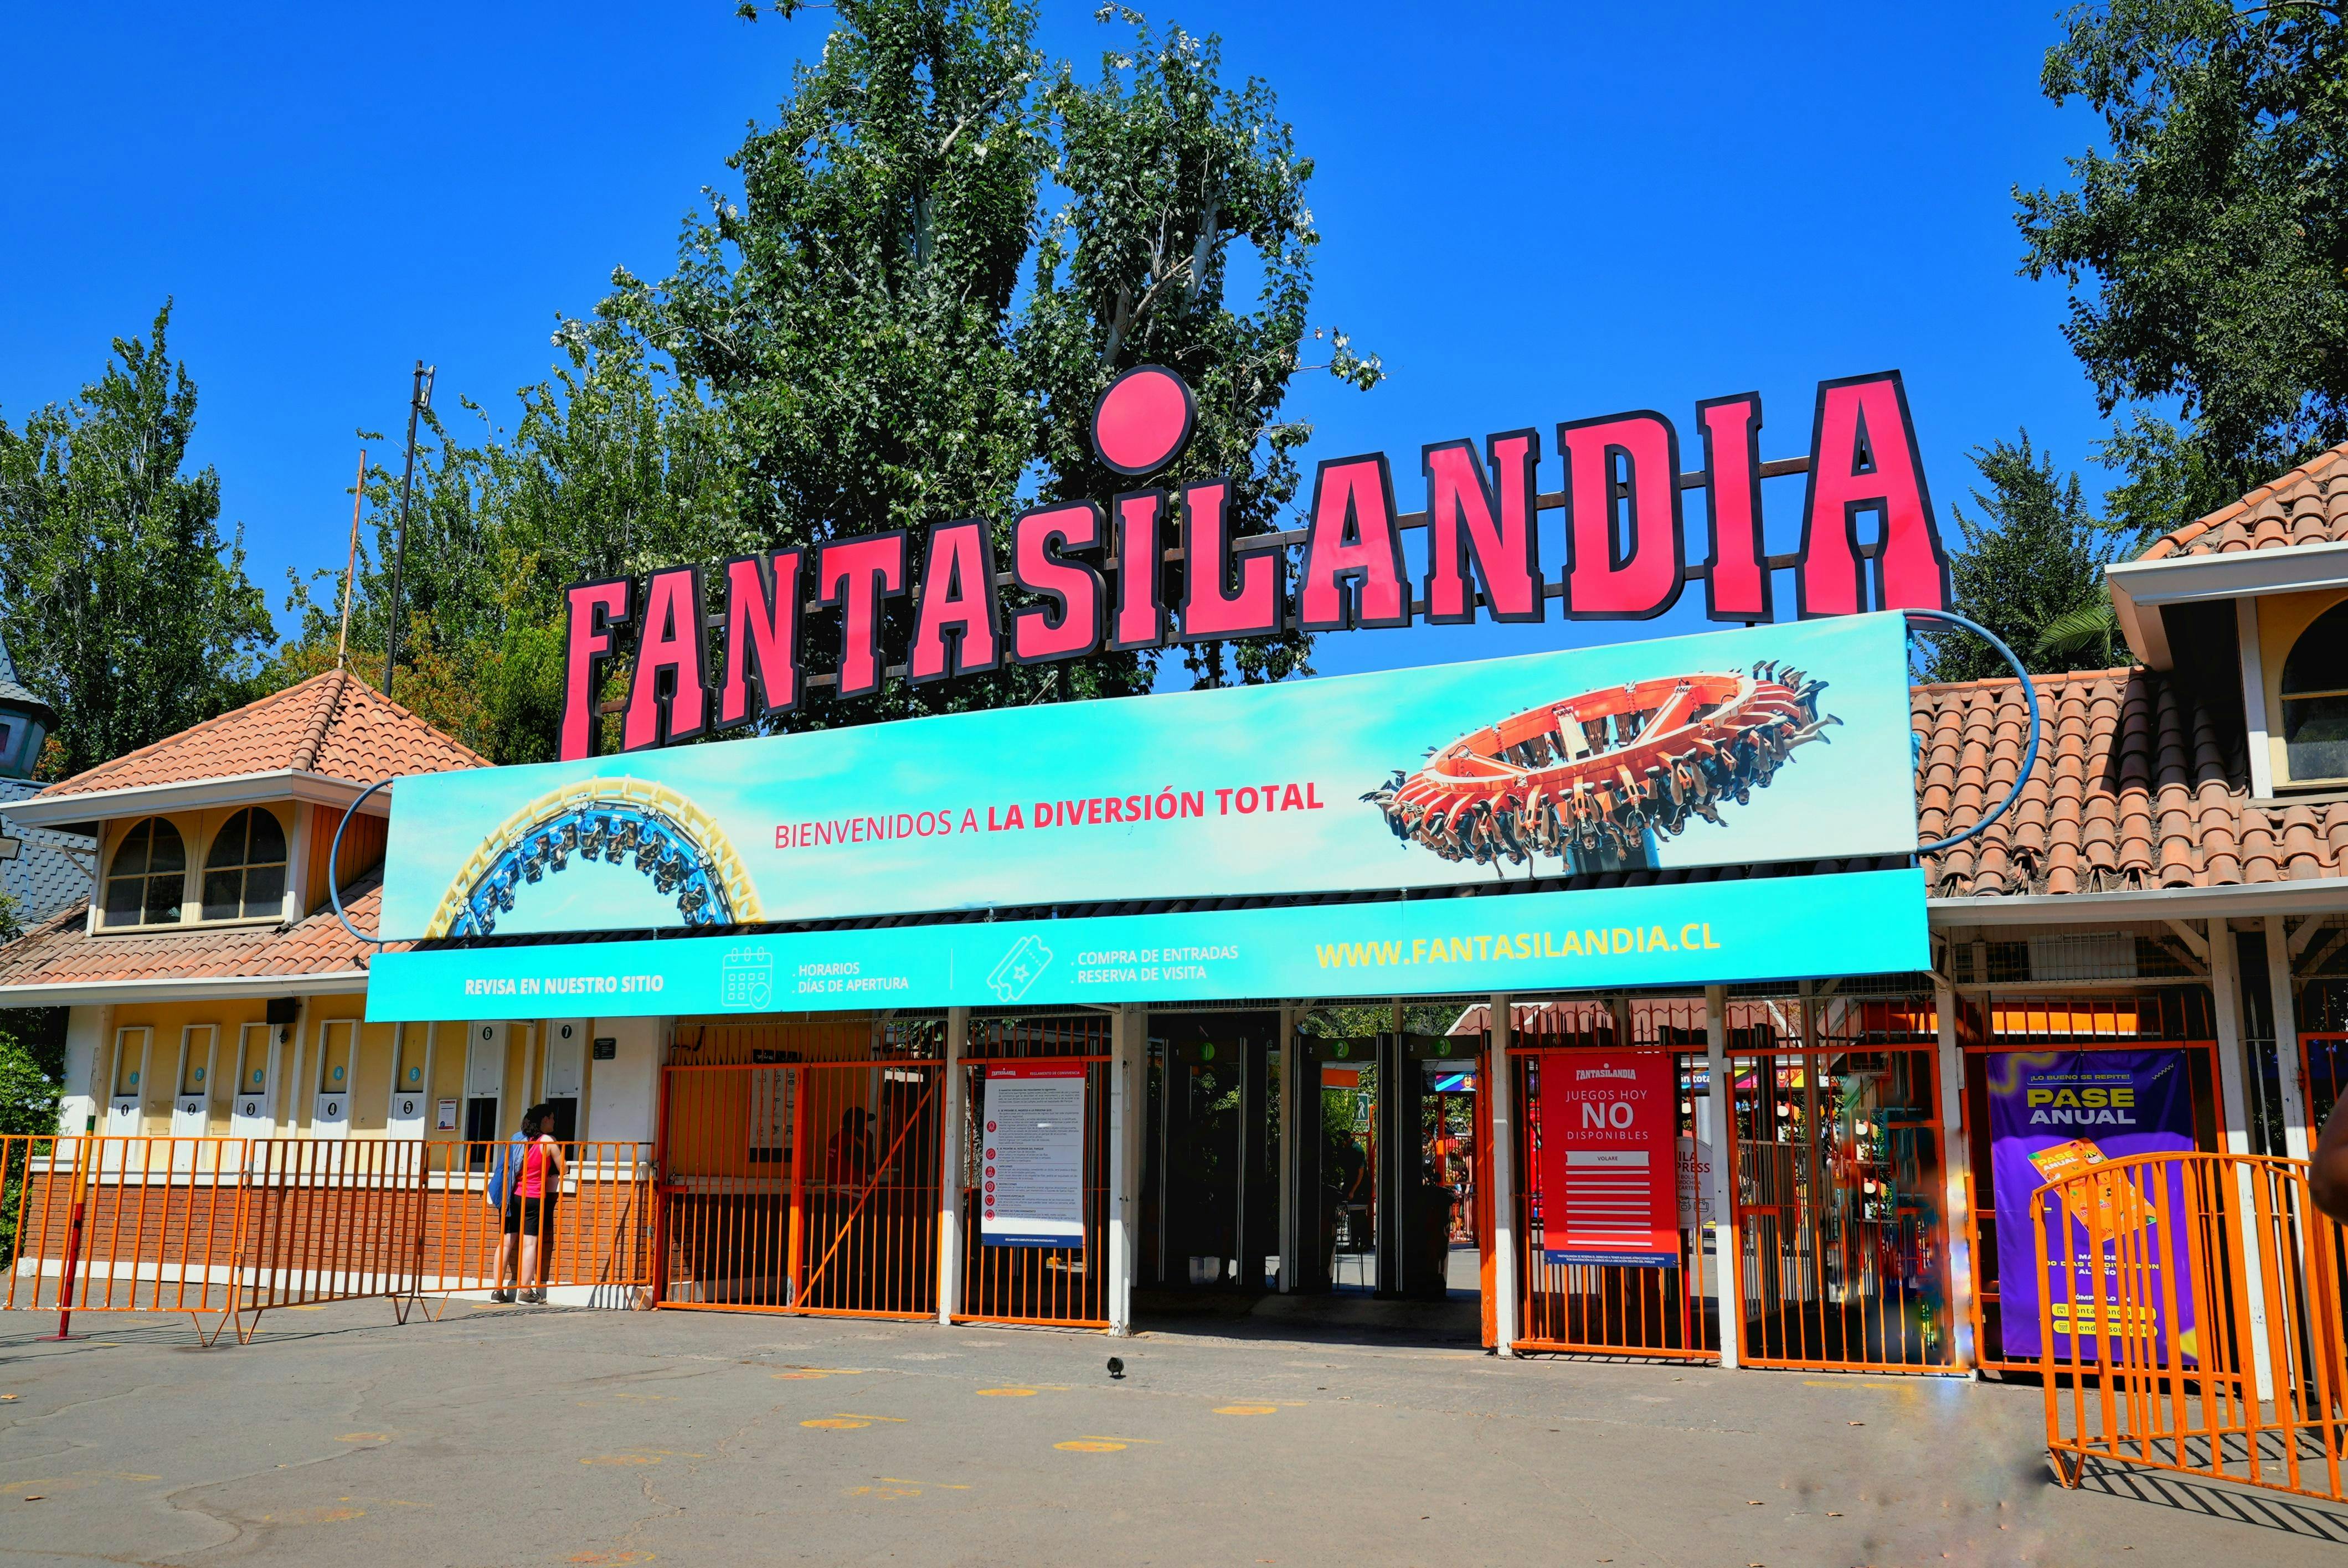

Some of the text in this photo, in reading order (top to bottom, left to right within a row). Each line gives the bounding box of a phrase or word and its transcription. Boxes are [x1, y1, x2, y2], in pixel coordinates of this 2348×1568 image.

[556, 364, 1952, 762] FANTASILANDIA
[775, 782, 1324, 849] BIENVENIDOS A LA DIVERSIÓN TOTAL
[1316, 923, 1721, 968] WWW.FANTASILANDIA.CL
[1078, 945, 1239, 965] COMPRA DE ENTRADAS
[799, 962, 860, 977] HORARIOS
[1078, 965, 1207, 983] RESERVA DE VISITA
[465, 974, 664, 995] REVISA EN NUESTRO SITIO
[798, 977, 909, 993] DÍAS DE APERTURA
[485, 1028, 490, 1039] 6
[564, 1027, 569, 1038] 7
[1338, 1043, 1344, 1056] 2
[1440, 1040, 1445, 1054] 3
[411, 1070, 416, 1079] 5
[1576, 1063, 1636, 1081] FANTASILANDIA
[1566, 1090, 1647, 1102] JUEGOS HOY
[2027, 1087, 2135, 1108] PASE
[189, 1105, 194, 1115] 2
[249, 1104, 254, 1115] 3
[329, 1103, 335, 1115] 4
[405, 1102, 411, 1113] 5
[1582, 1101, 1634, 1129] NO
[2029, 1109, 2136, 1125] ANUAL
[1567, 1131, 1649, 1140] DISPONIBLES
[1678, 1151, 1695, 1162] ILA
[2037, 1150, 2075, 1166] PASE
[1677, 1163, 1710, 1173] PRESS
[2043, 1157, 2079, 1171] ANUAL
